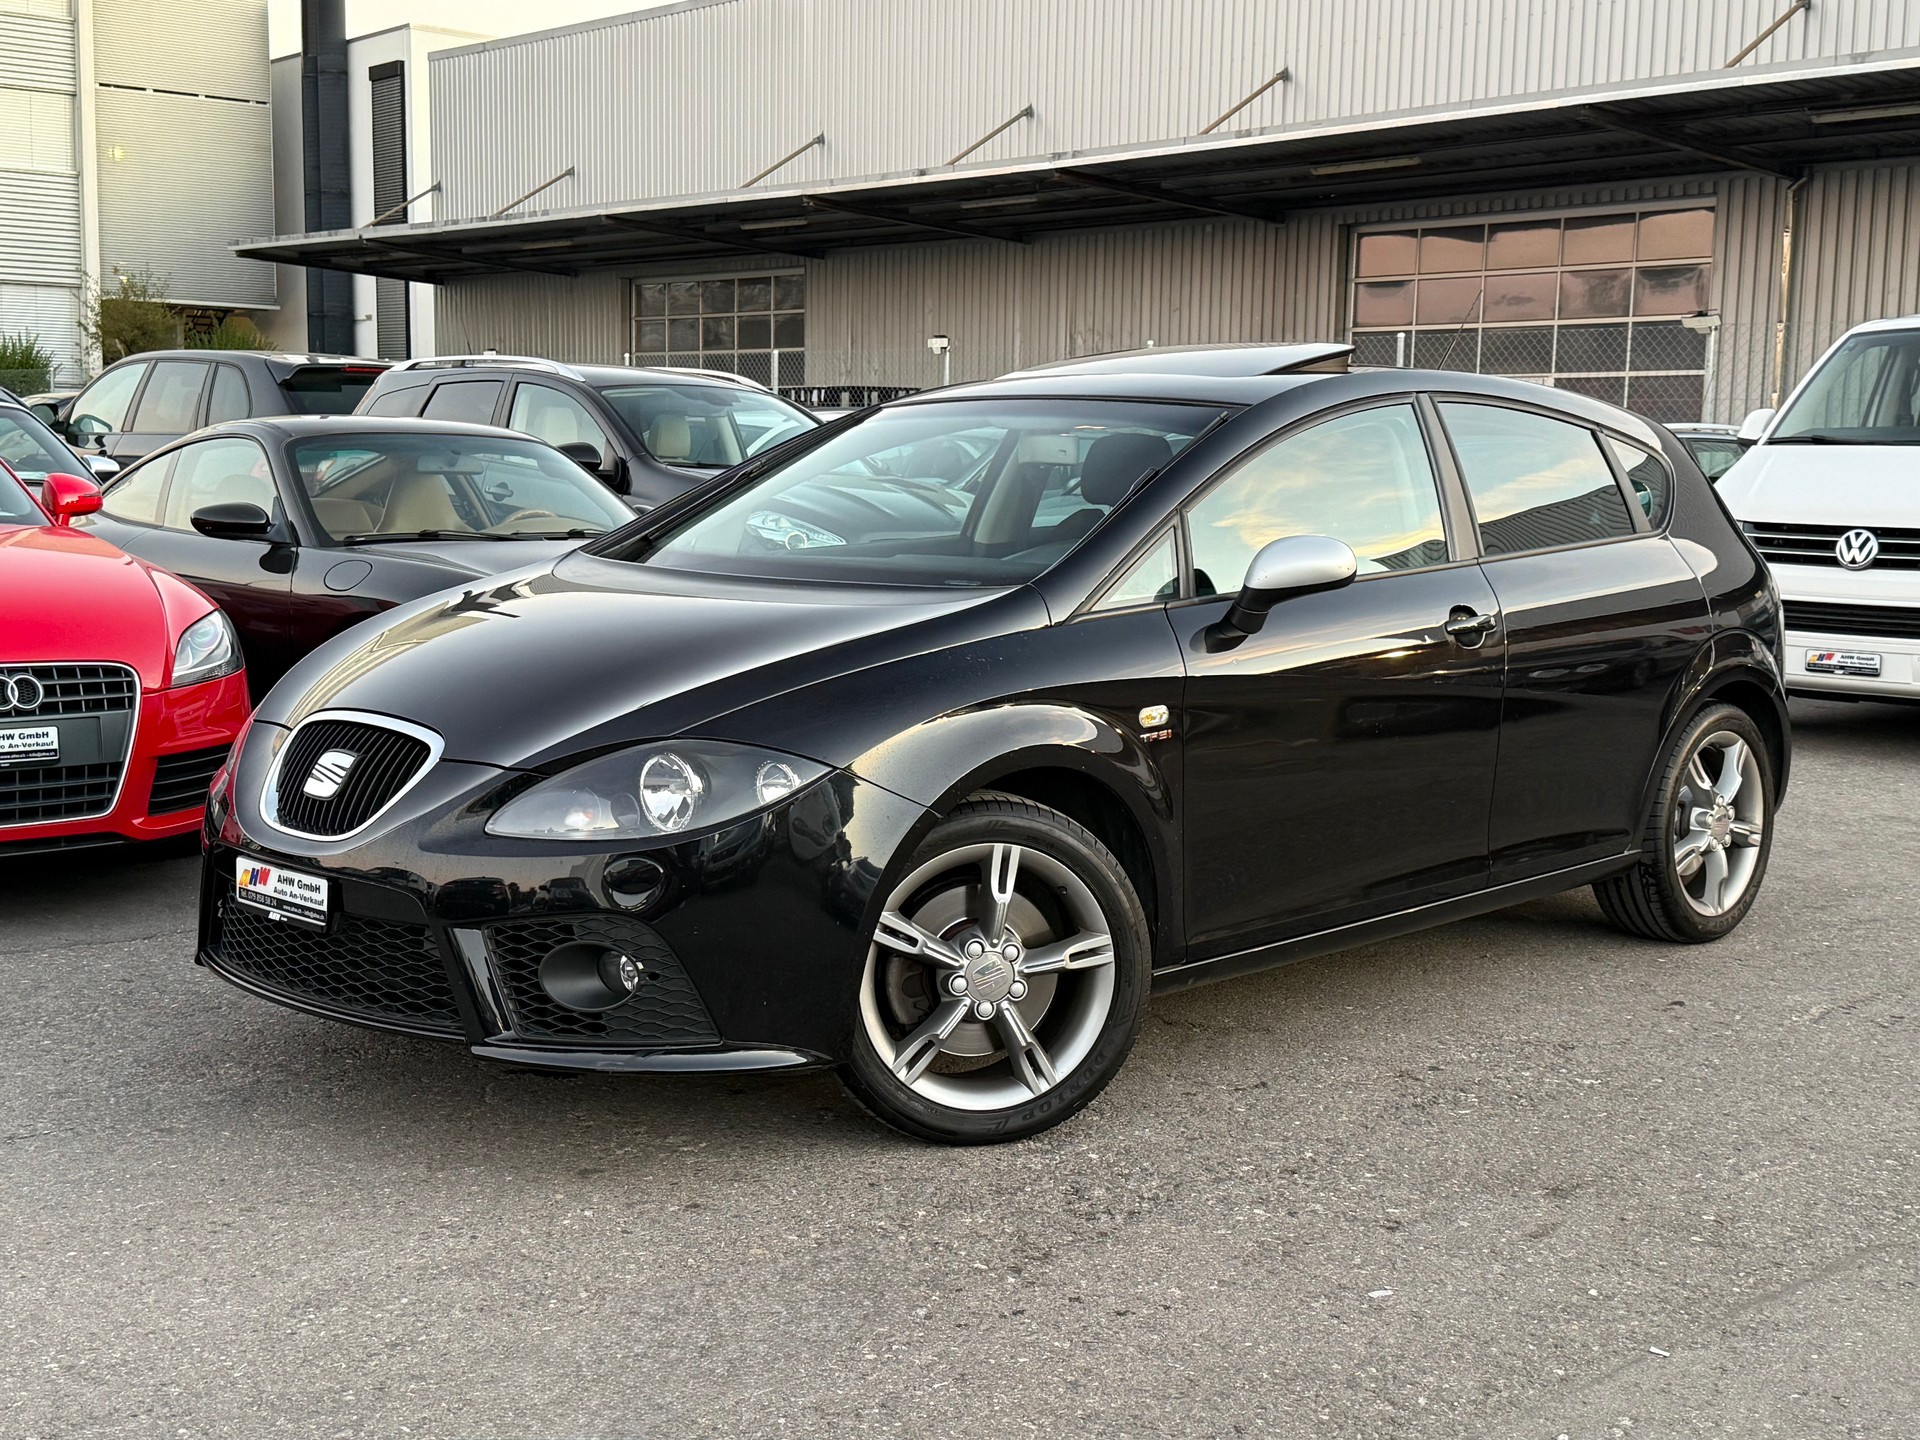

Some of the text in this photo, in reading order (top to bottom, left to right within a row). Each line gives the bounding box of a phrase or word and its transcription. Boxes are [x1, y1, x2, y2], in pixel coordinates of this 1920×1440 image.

[0, 731, 49, 741] HW GmbH
[1140, 729, 1173, 743] TFSI
[239, 867, 271, 887] AHW
[277, 874, 321, 895] AHW GmbH
[273, 886, 324, 906] Auto An-Verkauf
